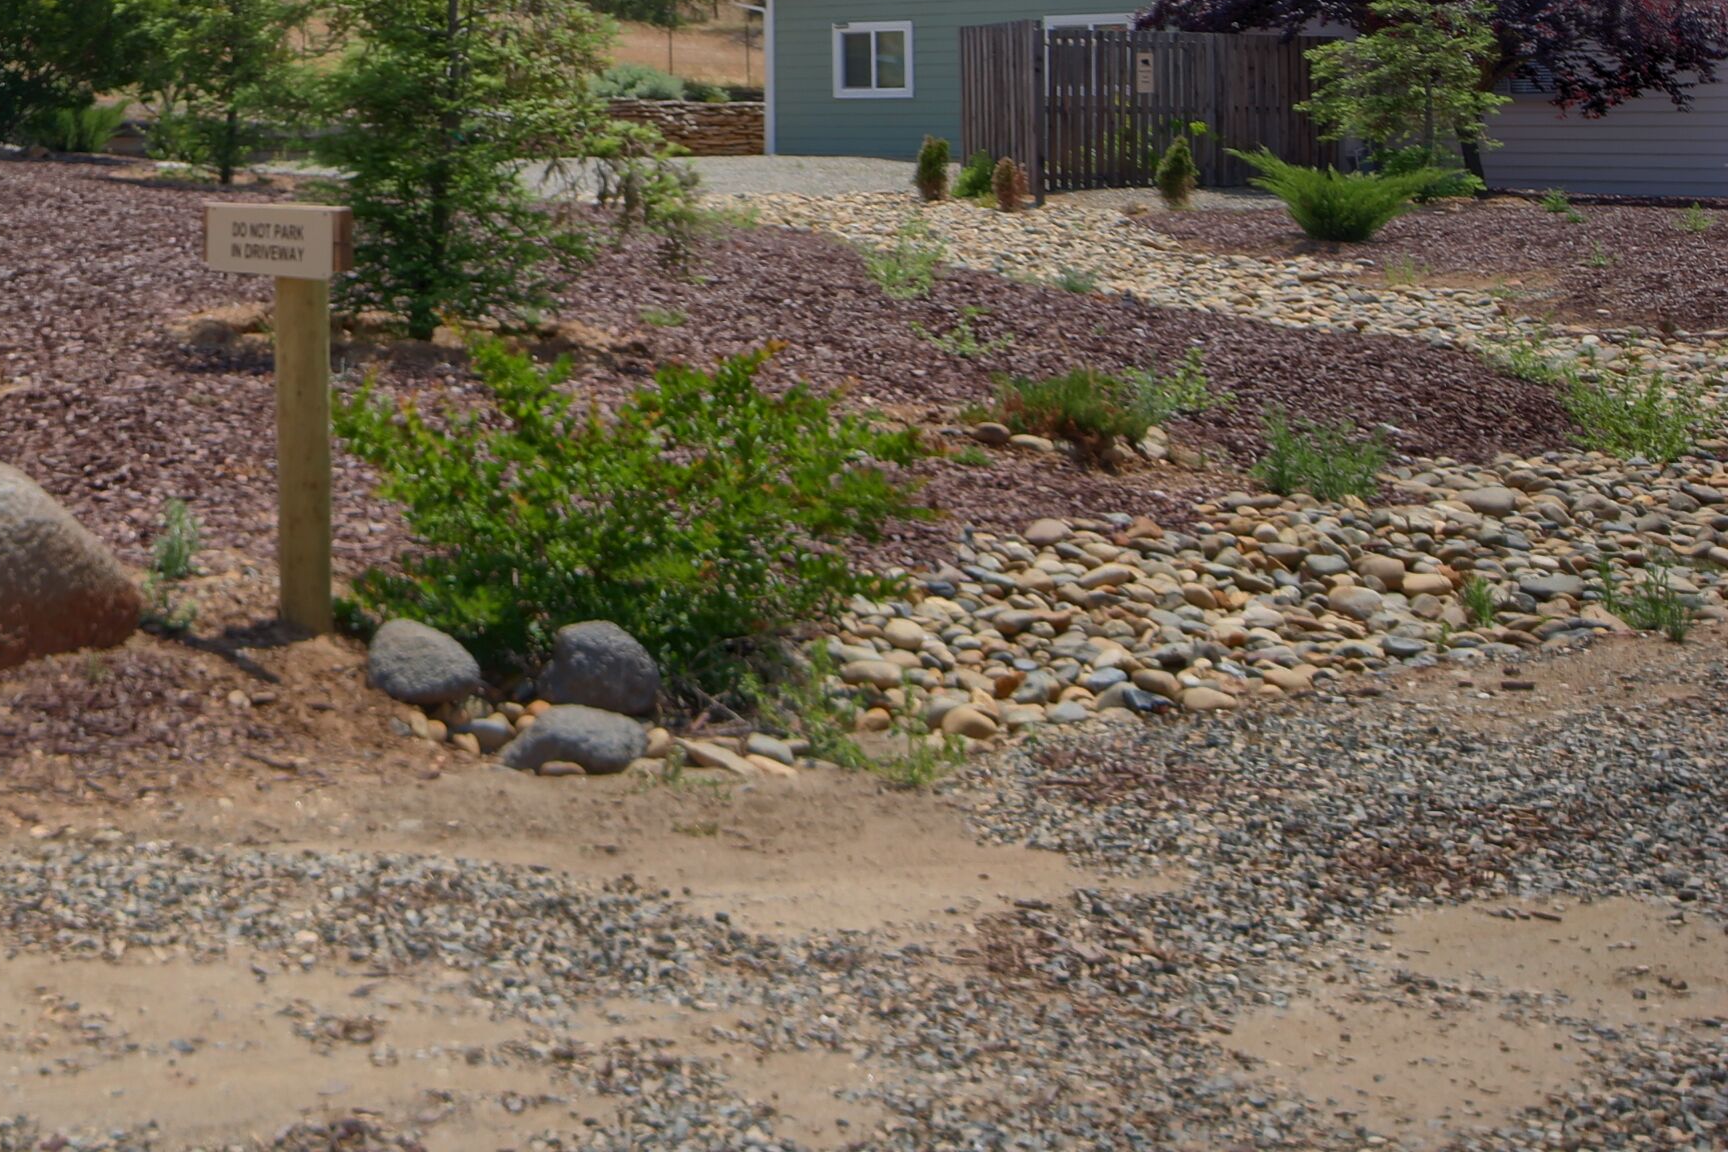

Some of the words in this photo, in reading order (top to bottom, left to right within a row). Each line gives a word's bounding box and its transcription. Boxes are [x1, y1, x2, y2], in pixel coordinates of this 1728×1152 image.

[232, 221, 247, 237] DO
[250, 223, 271, 239] NOT
[274, 223, 304, 240] PARK
[231, 243, 241, 258] IN
[244, 244, 304, 262] DRIVEWAY
